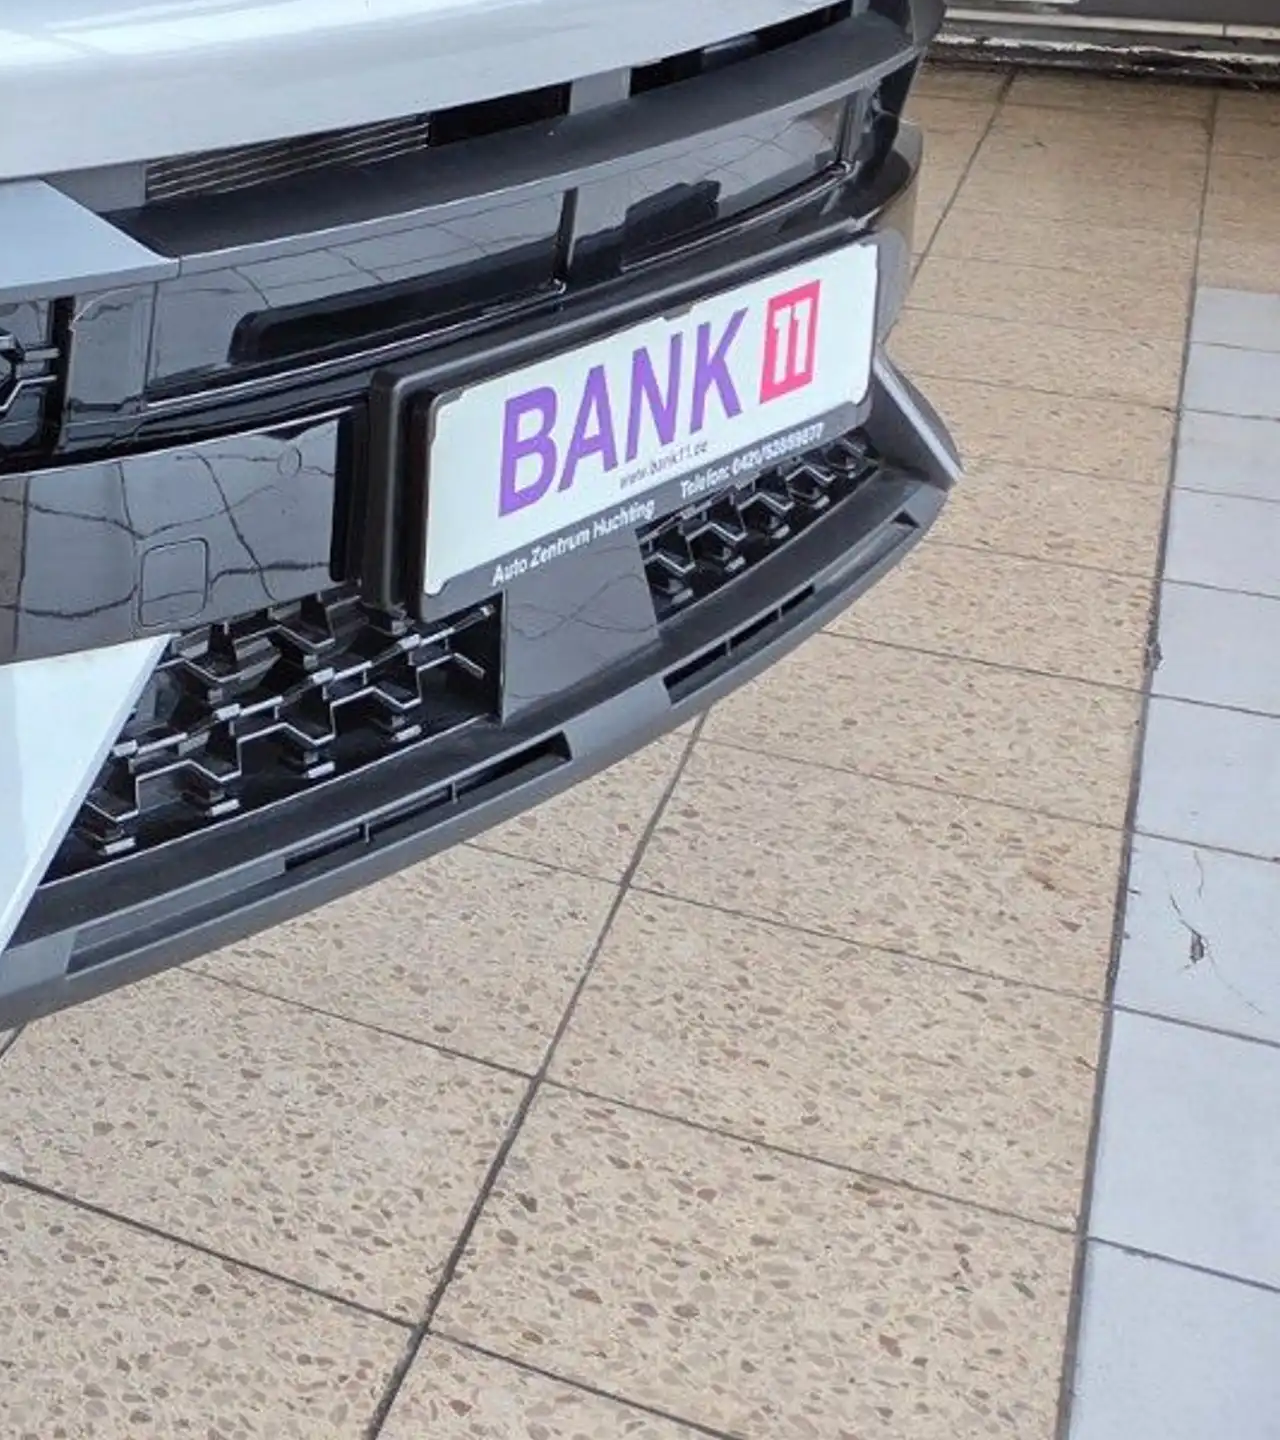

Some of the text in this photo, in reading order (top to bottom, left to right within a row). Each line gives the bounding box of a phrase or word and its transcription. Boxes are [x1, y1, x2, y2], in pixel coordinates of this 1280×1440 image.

[497, 290, 816, 518] BANK 11
[492, 556, 529, 587] Auto
[529, 528, 591, 568] Zentrum
[591, 499, 656, 540] Huchting
